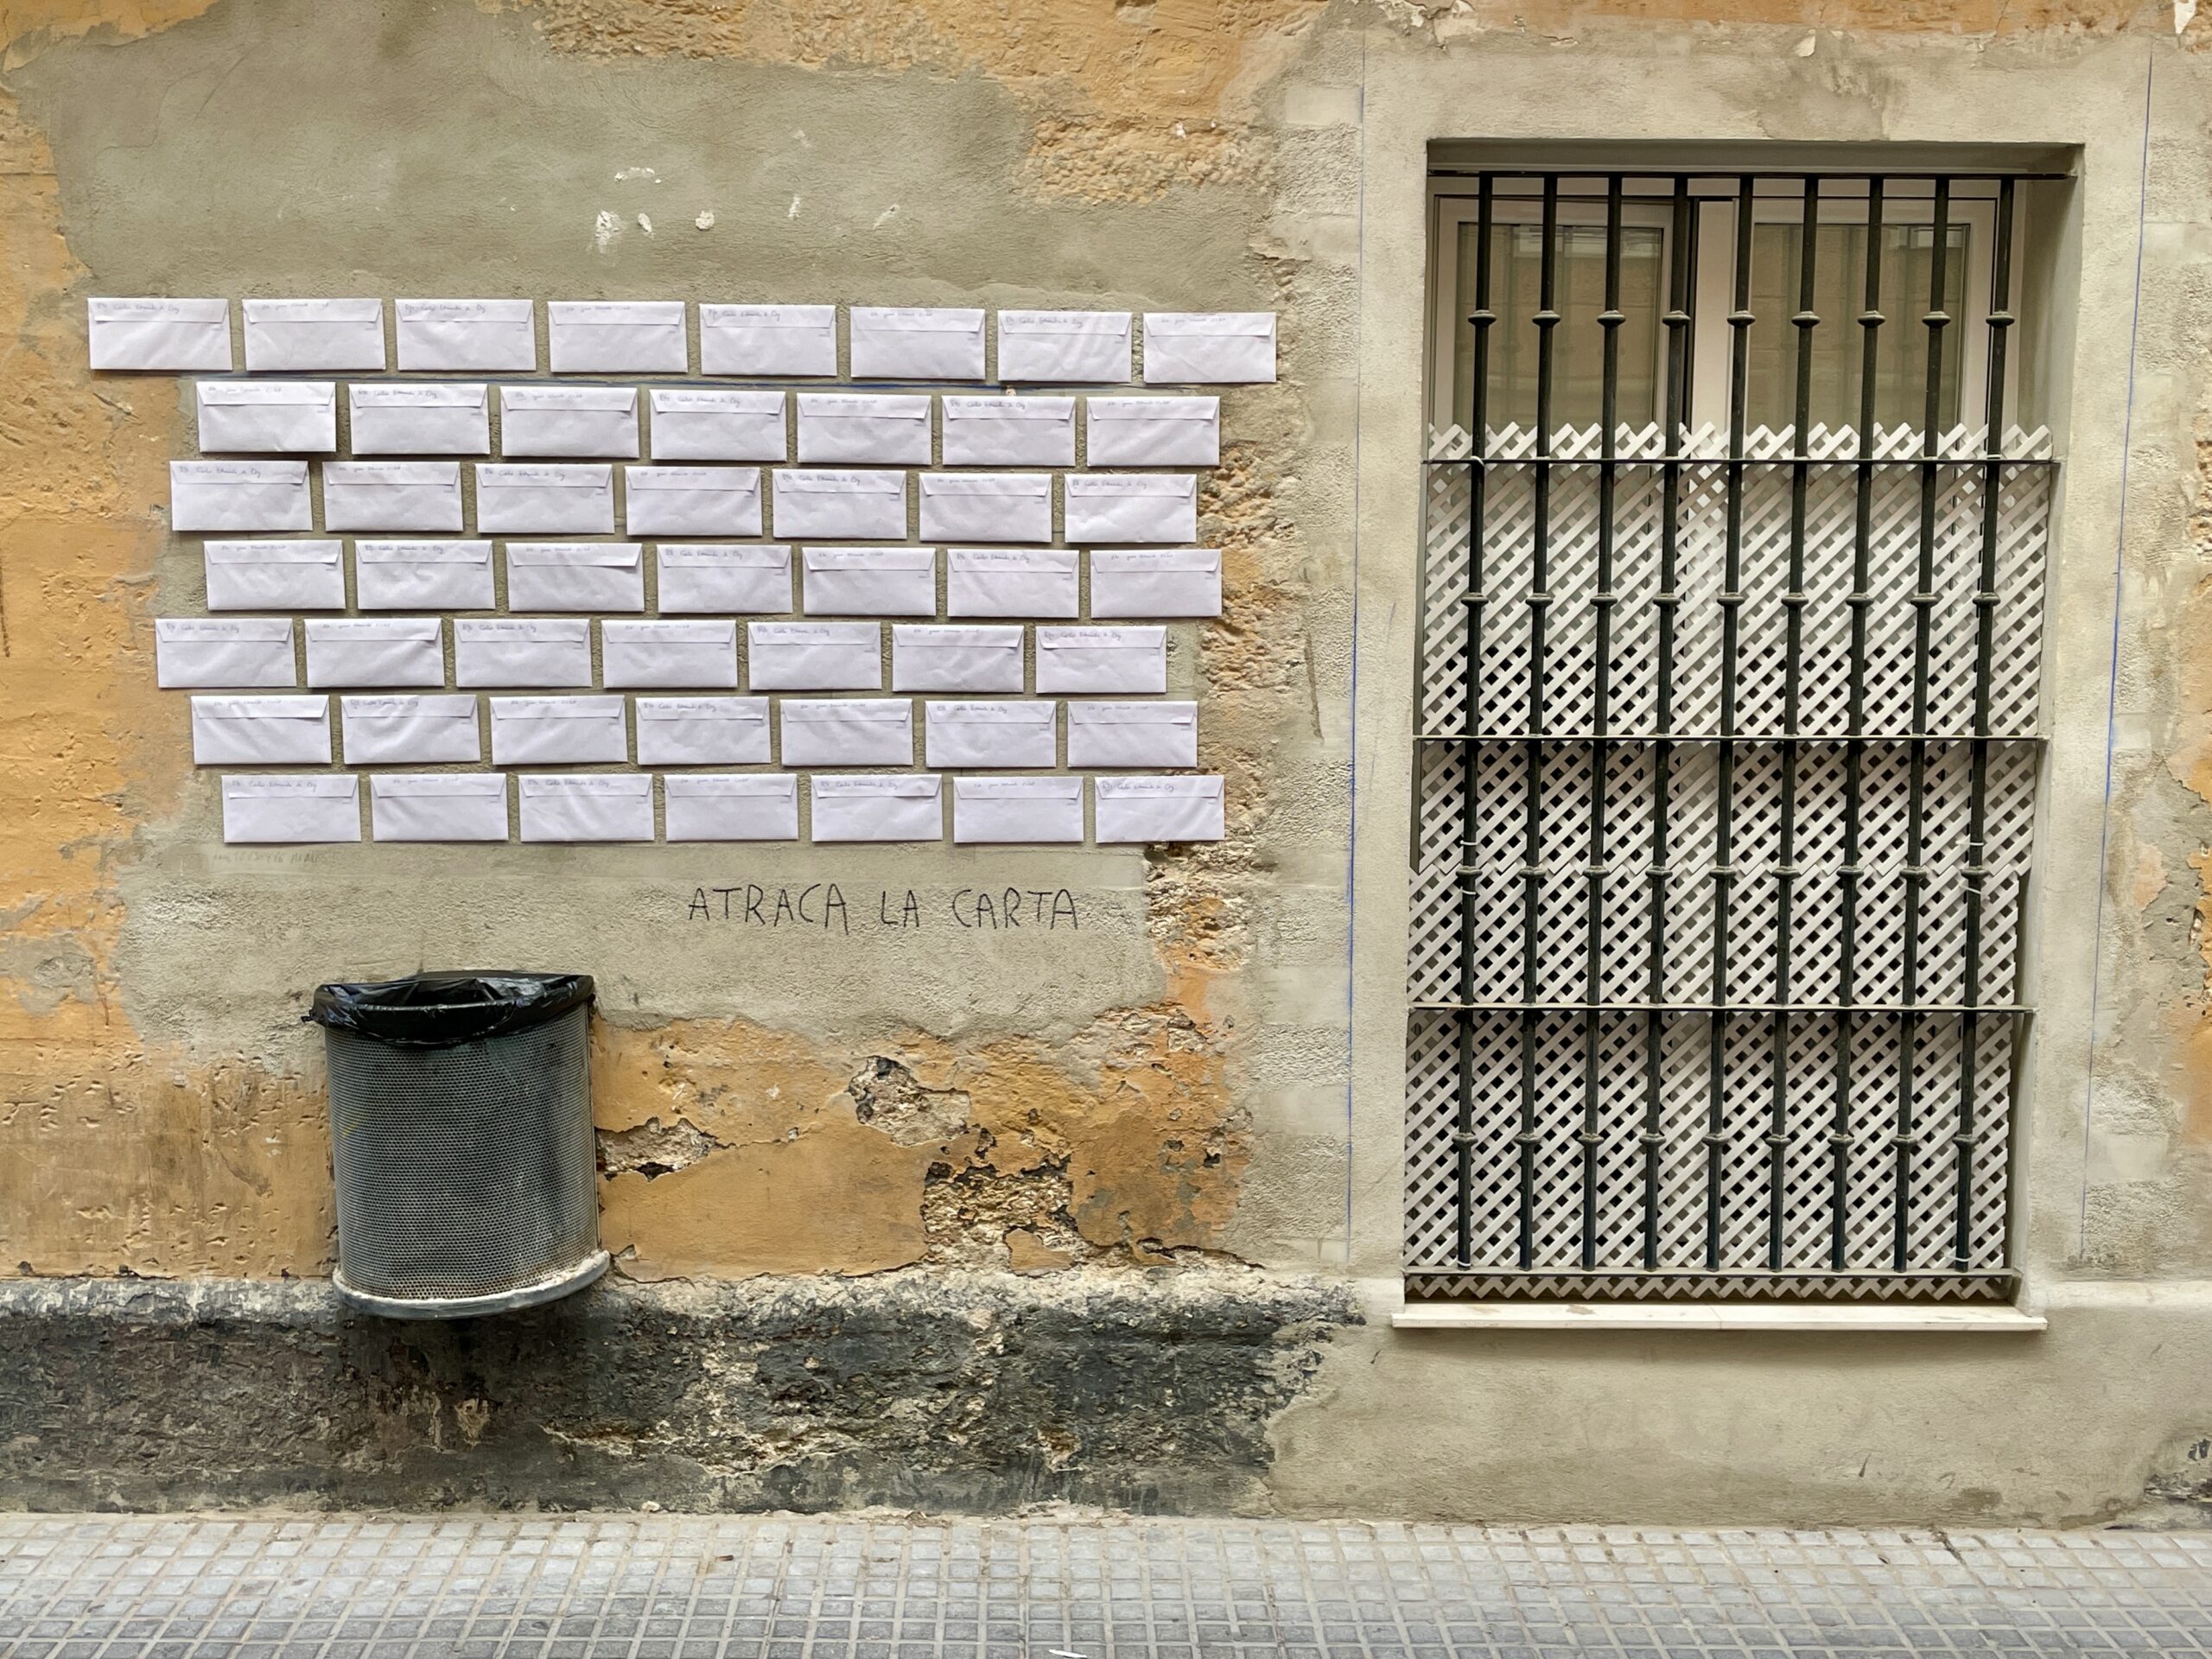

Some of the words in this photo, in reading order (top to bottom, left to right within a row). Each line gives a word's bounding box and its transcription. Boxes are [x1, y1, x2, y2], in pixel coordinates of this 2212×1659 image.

[689, 883, 849, 936] ATRACA
[880, 889, 919, 928] LA
[951, 887, 1078, 930] CARTA
